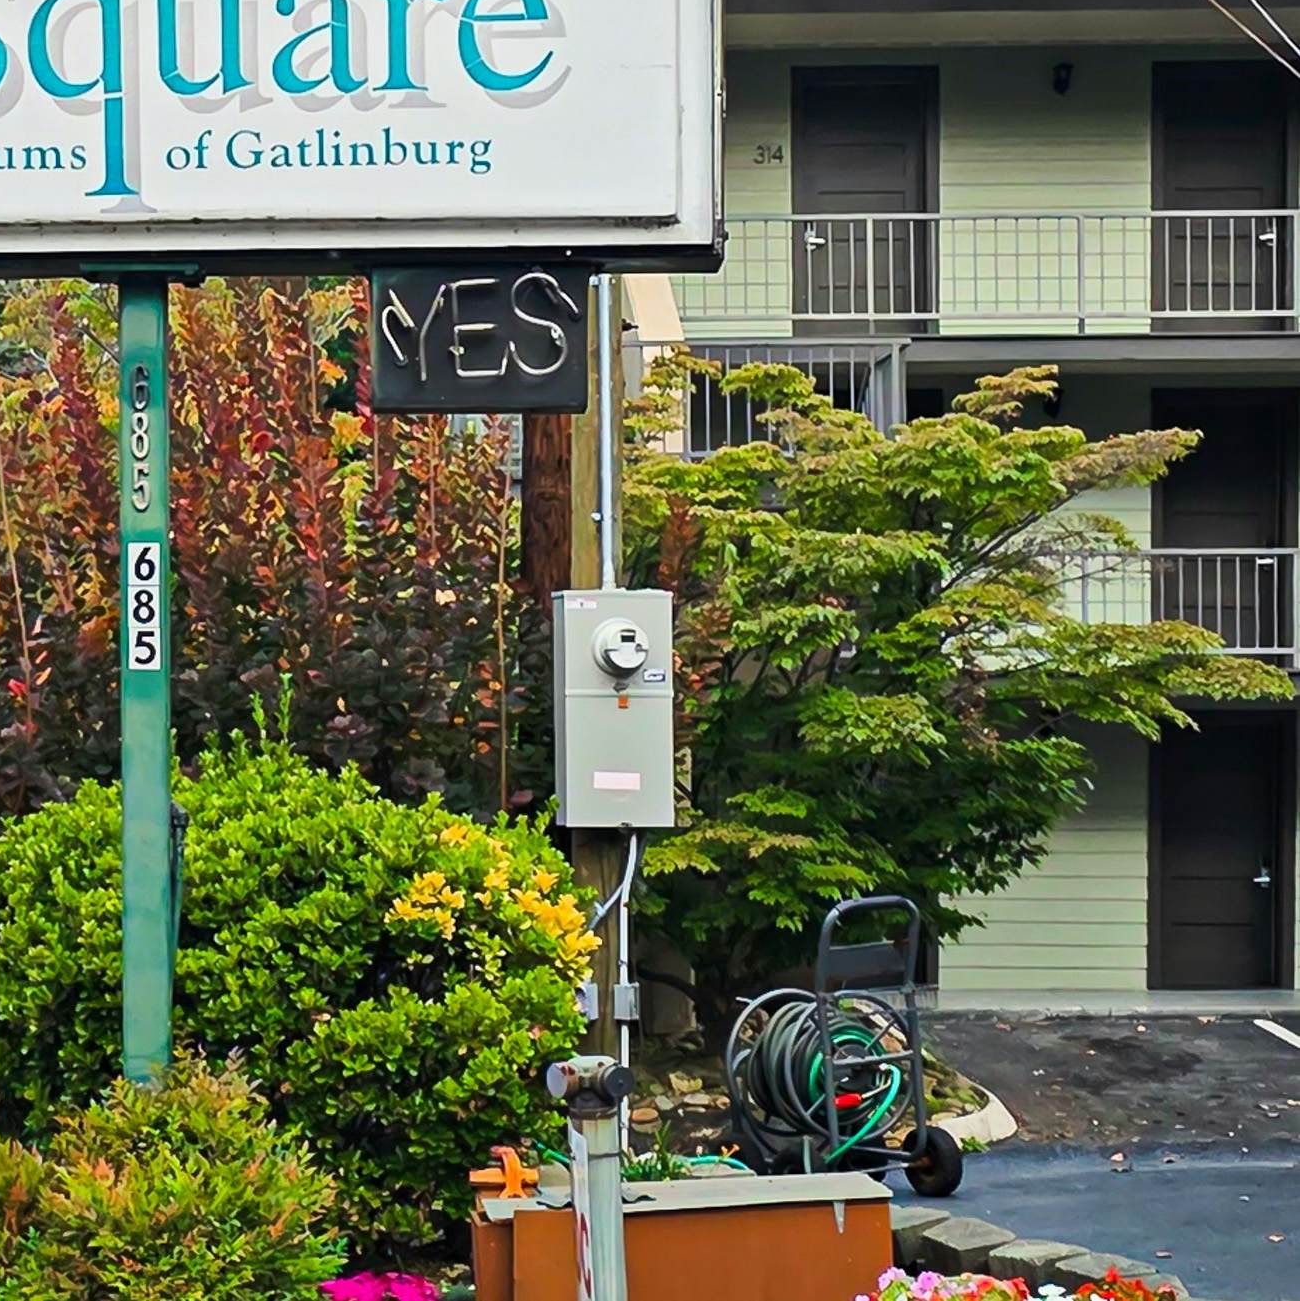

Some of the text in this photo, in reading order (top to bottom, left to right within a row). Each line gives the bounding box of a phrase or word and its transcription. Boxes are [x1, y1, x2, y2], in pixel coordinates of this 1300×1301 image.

[165, 126, 493, 174] of Gatlinburg
[752, 144, 784, 165] 314
[381, 271, 580, 382] YES
[131, 546, 157, 666] 685
